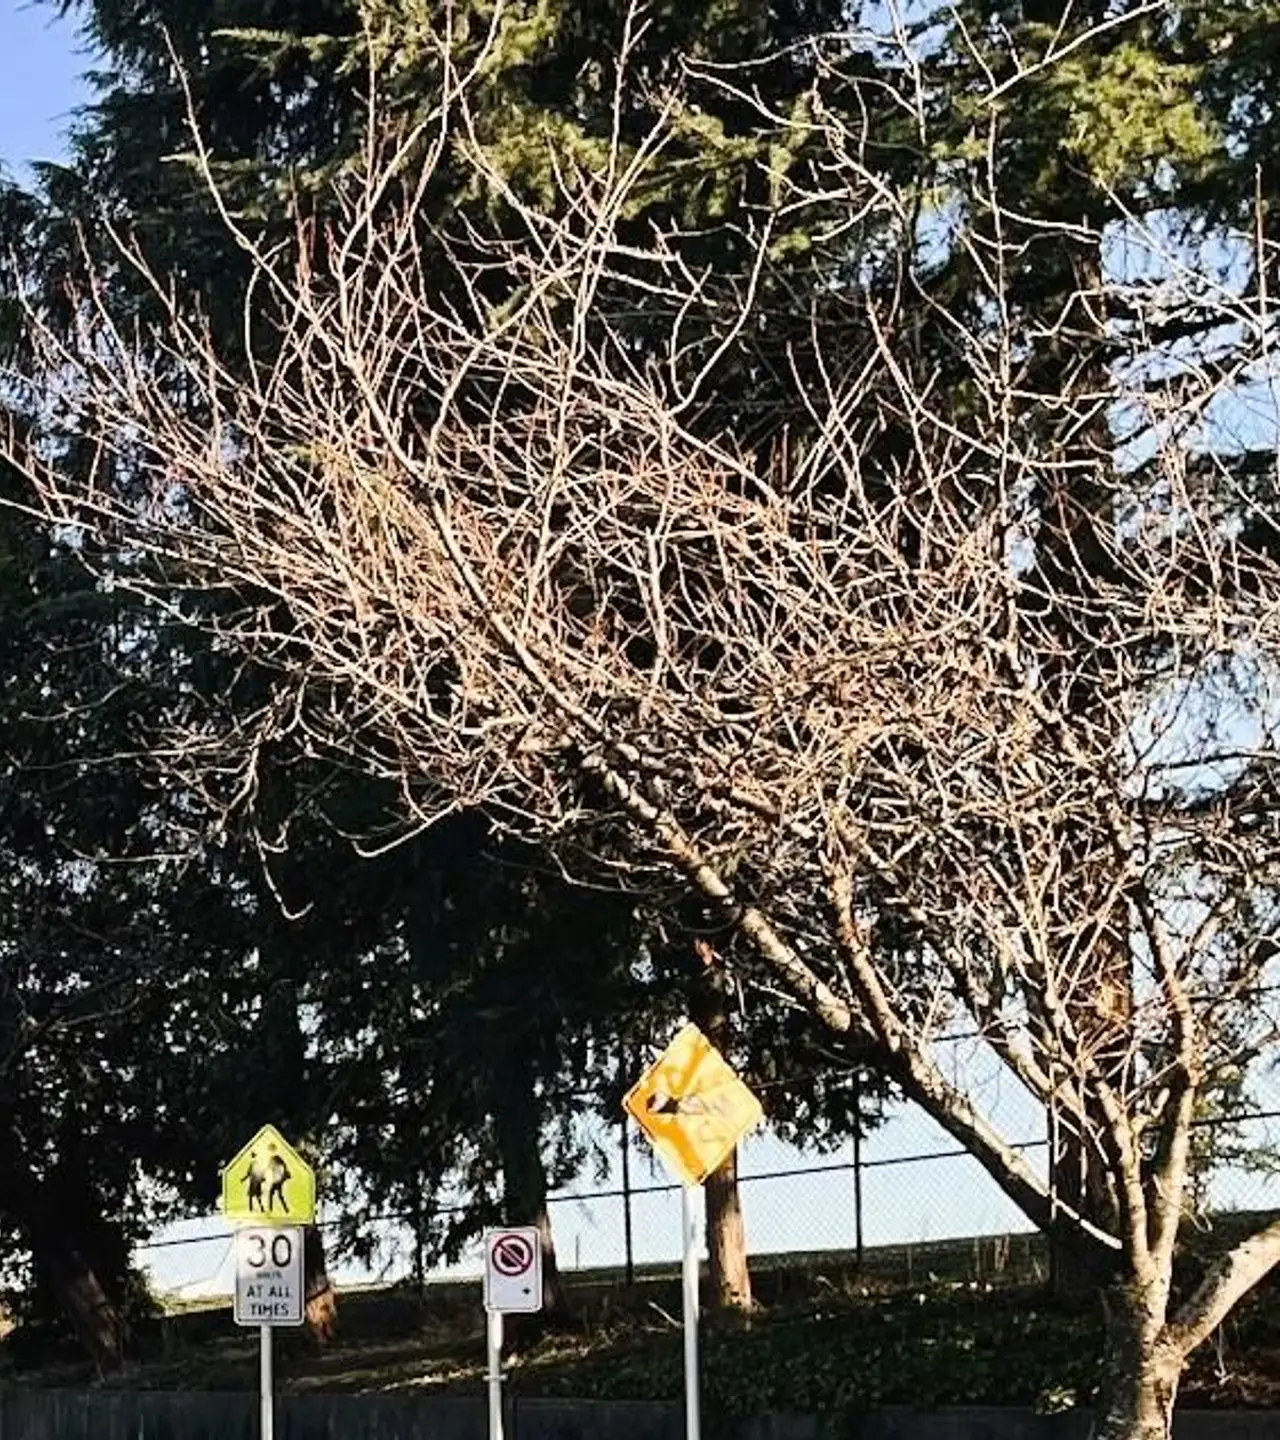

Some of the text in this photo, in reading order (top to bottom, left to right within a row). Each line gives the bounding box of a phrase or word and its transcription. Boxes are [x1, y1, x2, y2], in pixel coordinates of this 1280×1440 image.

[247, 1234, 291, 1267] 30
[247, 1285, 291, 1297] AT ALL
[250, 1303, 289, 1316] TIMES
